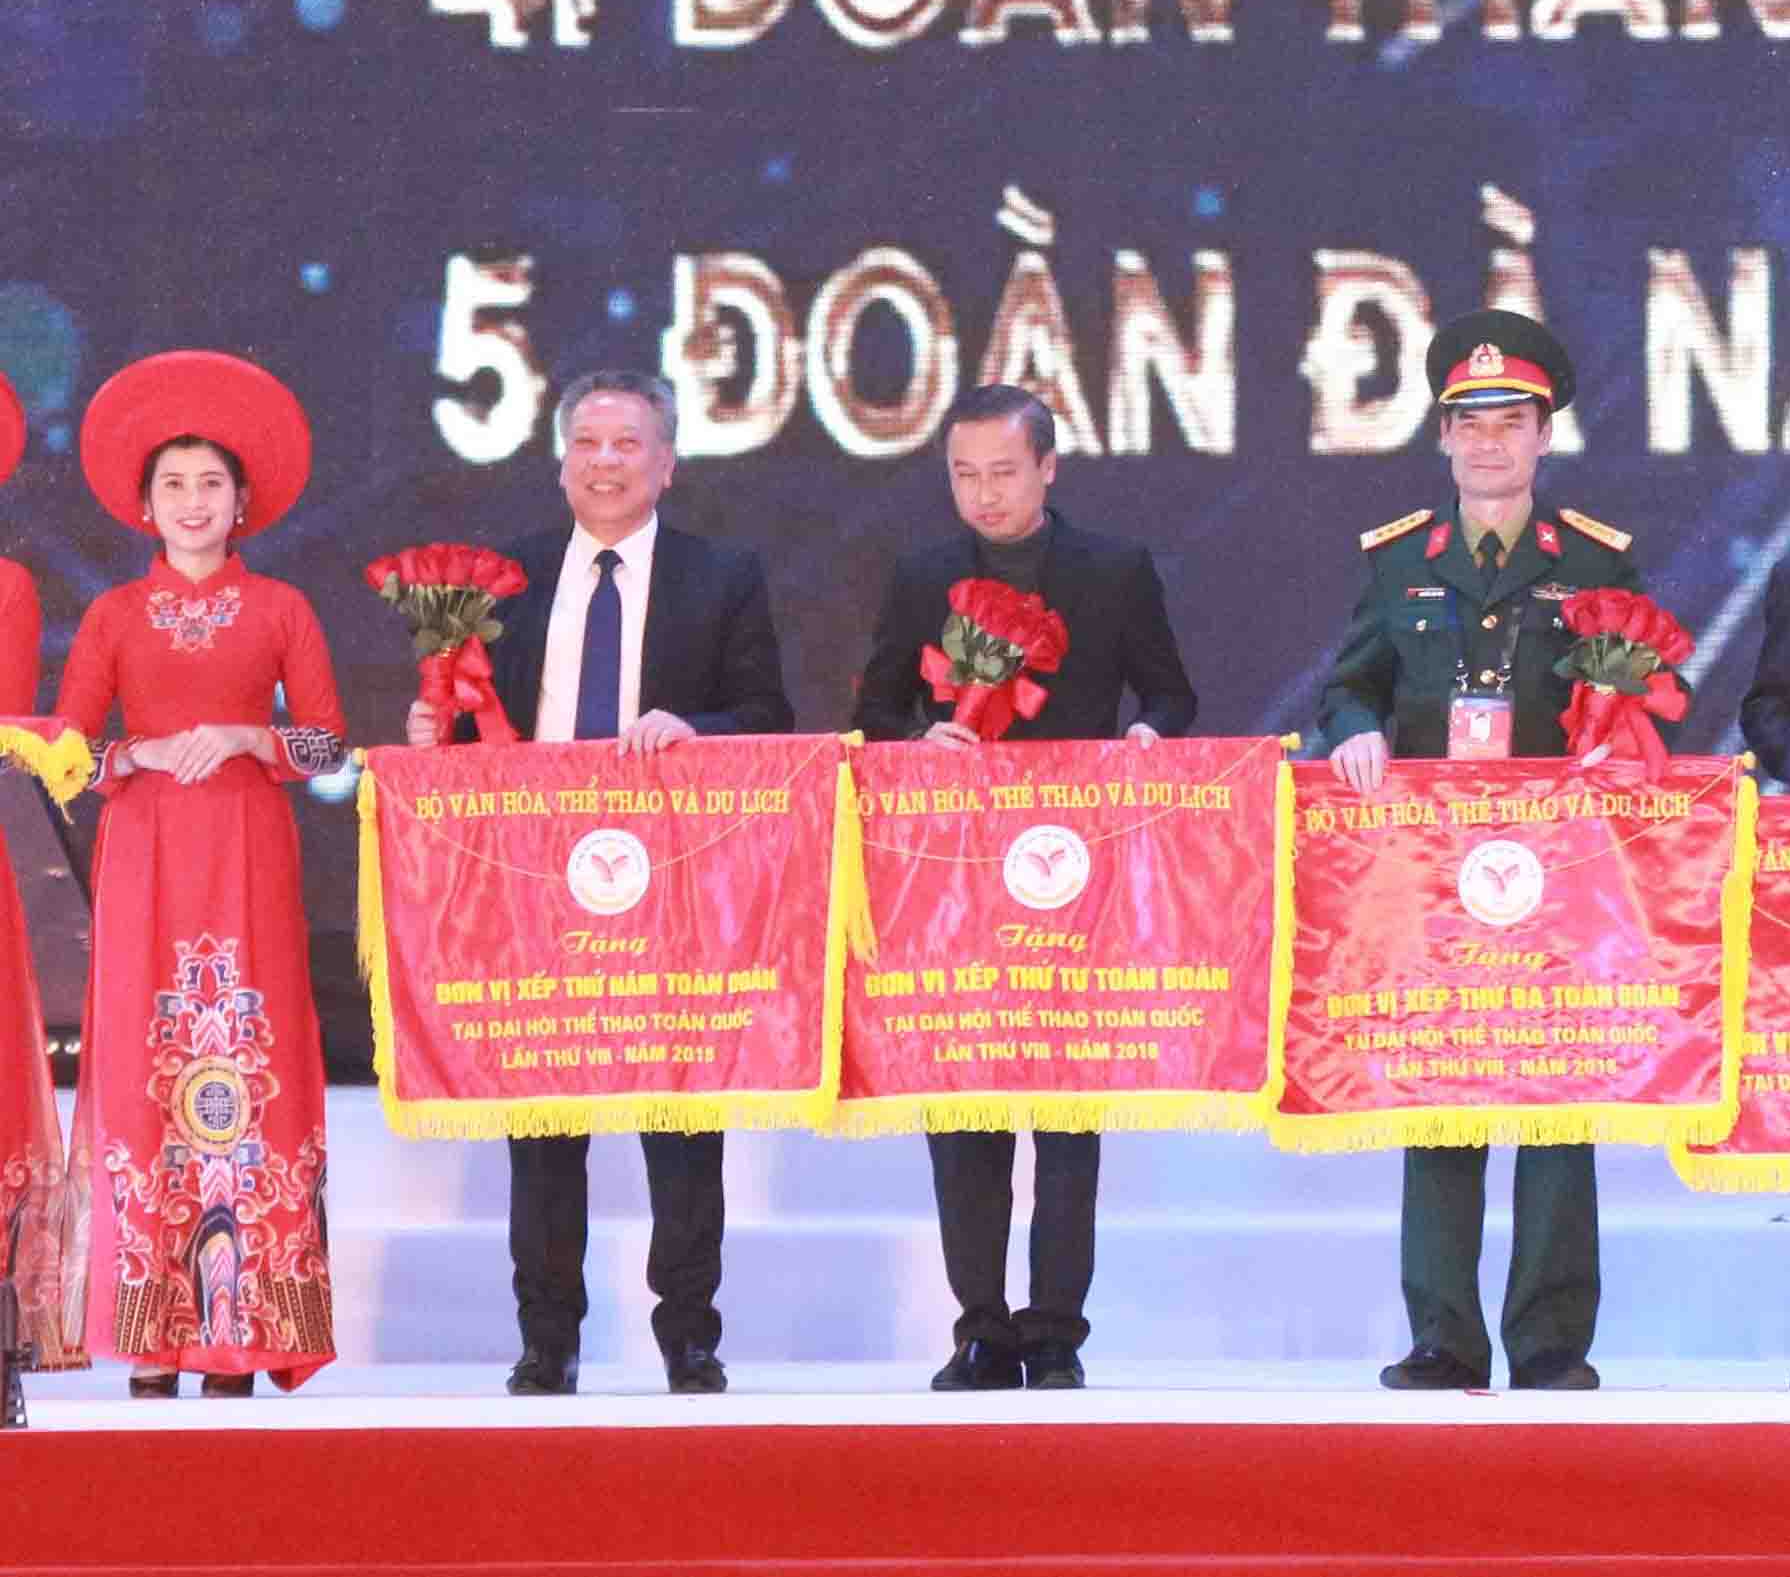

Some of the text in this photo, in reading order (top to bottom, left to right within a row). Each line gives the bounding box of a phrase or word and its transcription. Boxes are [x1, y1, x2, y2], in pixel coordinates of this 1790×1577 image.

[660, 185, 1237, 459] ĐOÀN
[603, 789, 664, 814] THAO
[706, 791, 737, 814] DU
[1039, 785, 1101, 809] THAO
[1143, 785, 1174, 807] DU
